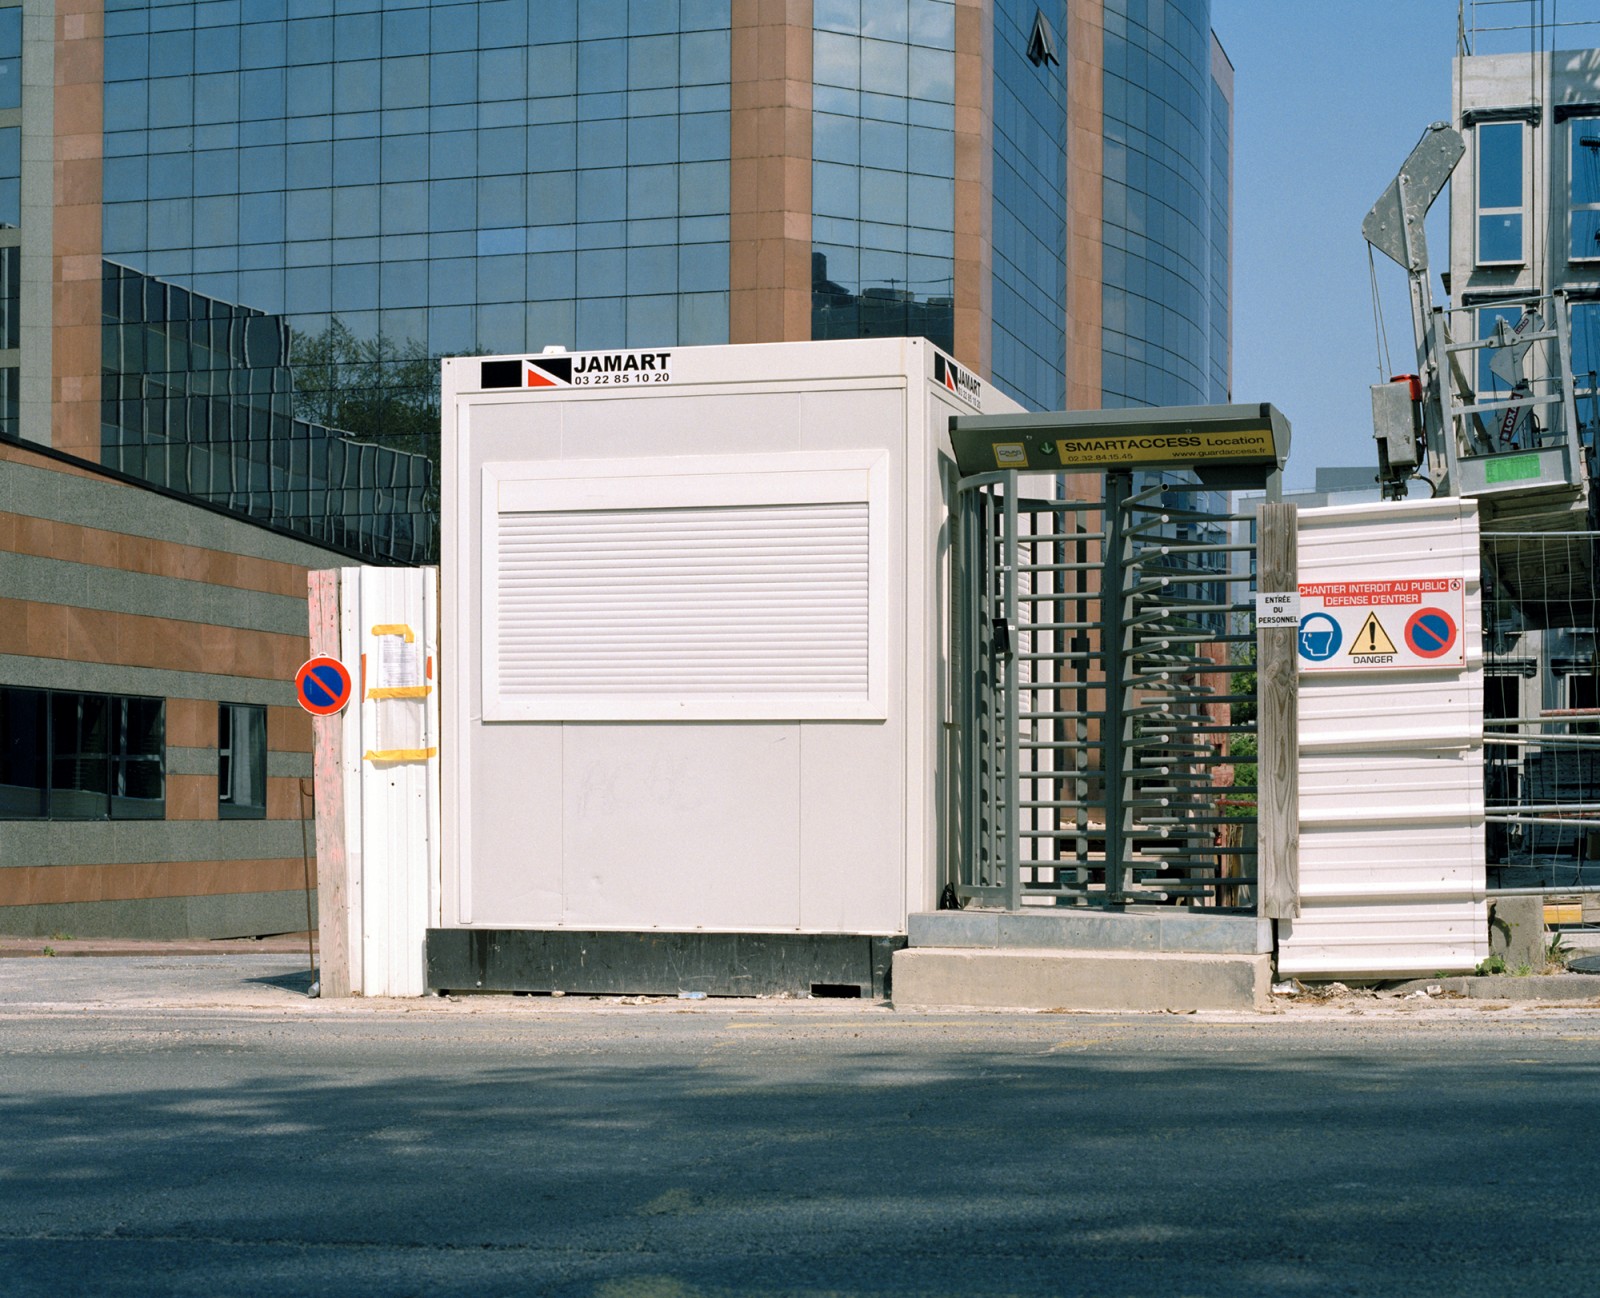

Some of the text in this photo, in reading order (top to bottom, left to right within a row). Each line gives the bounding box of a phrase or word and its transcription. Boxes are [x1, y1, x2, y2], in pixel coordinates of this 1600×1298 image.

[574, 353, 671, 373] JAMART
[575, 372, 670, 385] 03 22 85 10 20
[958, 369, 981, 398] JAMART
[1065, 436, 1265, 452] SMARTACCESS Location
[1068, 447, 1266, 462] 02.32.84.15.45 www.guardaccess.fr
[1298, 581, 1446, 595] CHANTIER INTERDIT AU PUBLIC
[1265, 595, 1291, 604] ENTRÉE
[1325, 594, 1419, 606] DEFENSE D'ENTRER
[1258, 616, 1298, 624] PERSONNEL
[1353, 655, 1393, 664] DANGER
